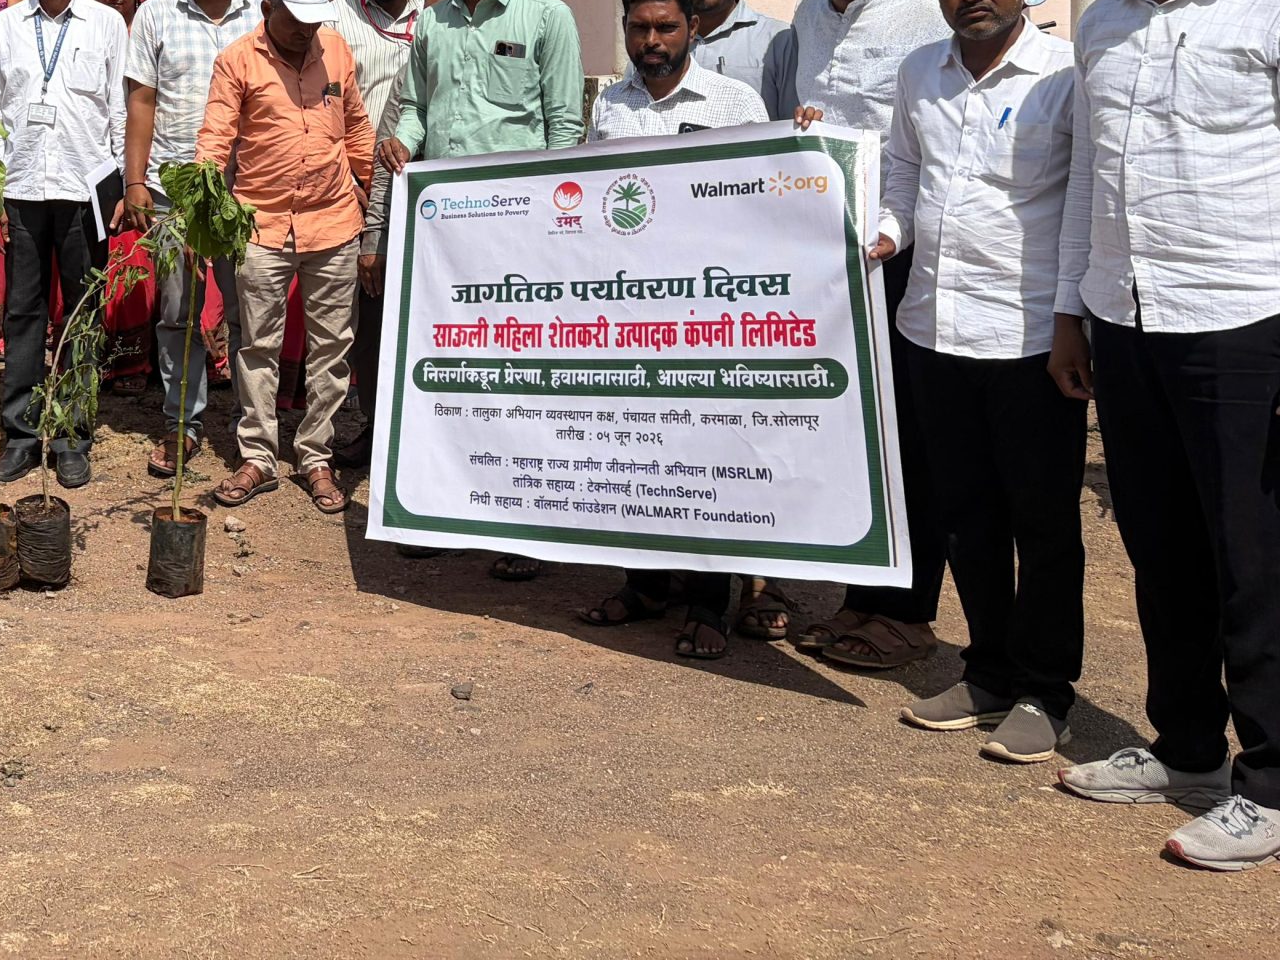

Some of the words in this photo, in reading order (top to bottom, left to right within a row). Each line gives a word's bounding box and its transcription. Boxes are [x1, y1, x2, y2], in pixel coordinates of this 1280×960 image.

[691, 178, 765, 199] Walmart
[794, 175, 828, 193] org
[440, 194, 531, 210] TechnoServe
[505, 208, 530, 216] Poverty
[552, 212, 583, 229] उमेद
[451, 273, 564, 304] जागतिक
[570, 269, 695, 302] पर्यावरण
[703, 265, 791, 302] दिवस
[432, 316, 489, 349] साऊली
[493, 316, 544, 353] महिला
[548, 314, 609, 349] शेतकरी
[614, 318, 678, 353] उत्पादक
[684, 309, 736, 348] कंपनी
[739, 310, 817, 348] लिमिटेड
[422, 361, 501, 392] निसर्गाकडून
[504, 362, 546, 388] प्रेरणा,
[550, 364, 652, 390] हवामानासाठी,
[657, 368, 716, 388] आपल्या
[719, 363, 835, 389] भविष्यासाठी.
[434, 402, 462, 417] ठिकाण
[472, 407, 502, 421] तालुका
[506, 406, 542, 420] अभियान
[546, 409, 593, 422] व्यवस्थापन
[596, 410, 619, 425] कक्ष,
[623, 408, 656, 424] पंचायत
[660, 409, 696, 426] समिती,
[700, 413, 747, 428] करमाळा,
[752, 411, 820, 431] जि.सोलापूर
[556, 426, 585, 441] तारीख
[596, 431, 611, 443] ०५
[614, 431, 631, 446] जून
[635, 431, 664, 446] २०२६
[469, 451, 502, 467] संचलित
[512, 457, 544, 472] महाराष्ट्र
[547, 458, 569, 471] राज्य
[573, 456, 602, 473] ग्रामीण
[606, 458, 660, 475] जीवनोन्नती
[664, 461, 707, 478] अभियान
[711, 465, 773, 484] (MSRLM)
[512, 473, 543, 490] तांत्रिक
[546, 479, 575, 492] सहाय्य
[635, 482, 717, 503] (TechnServe)
[469, 490, 491, 506] निधी
[494, 495, 523, 509] सहाय्य
[533, 494, 569, 512] वॉलमार्ट
[621, 503, 690, 520] (WALMART
[694, 507, 776, 527] Foundation)
